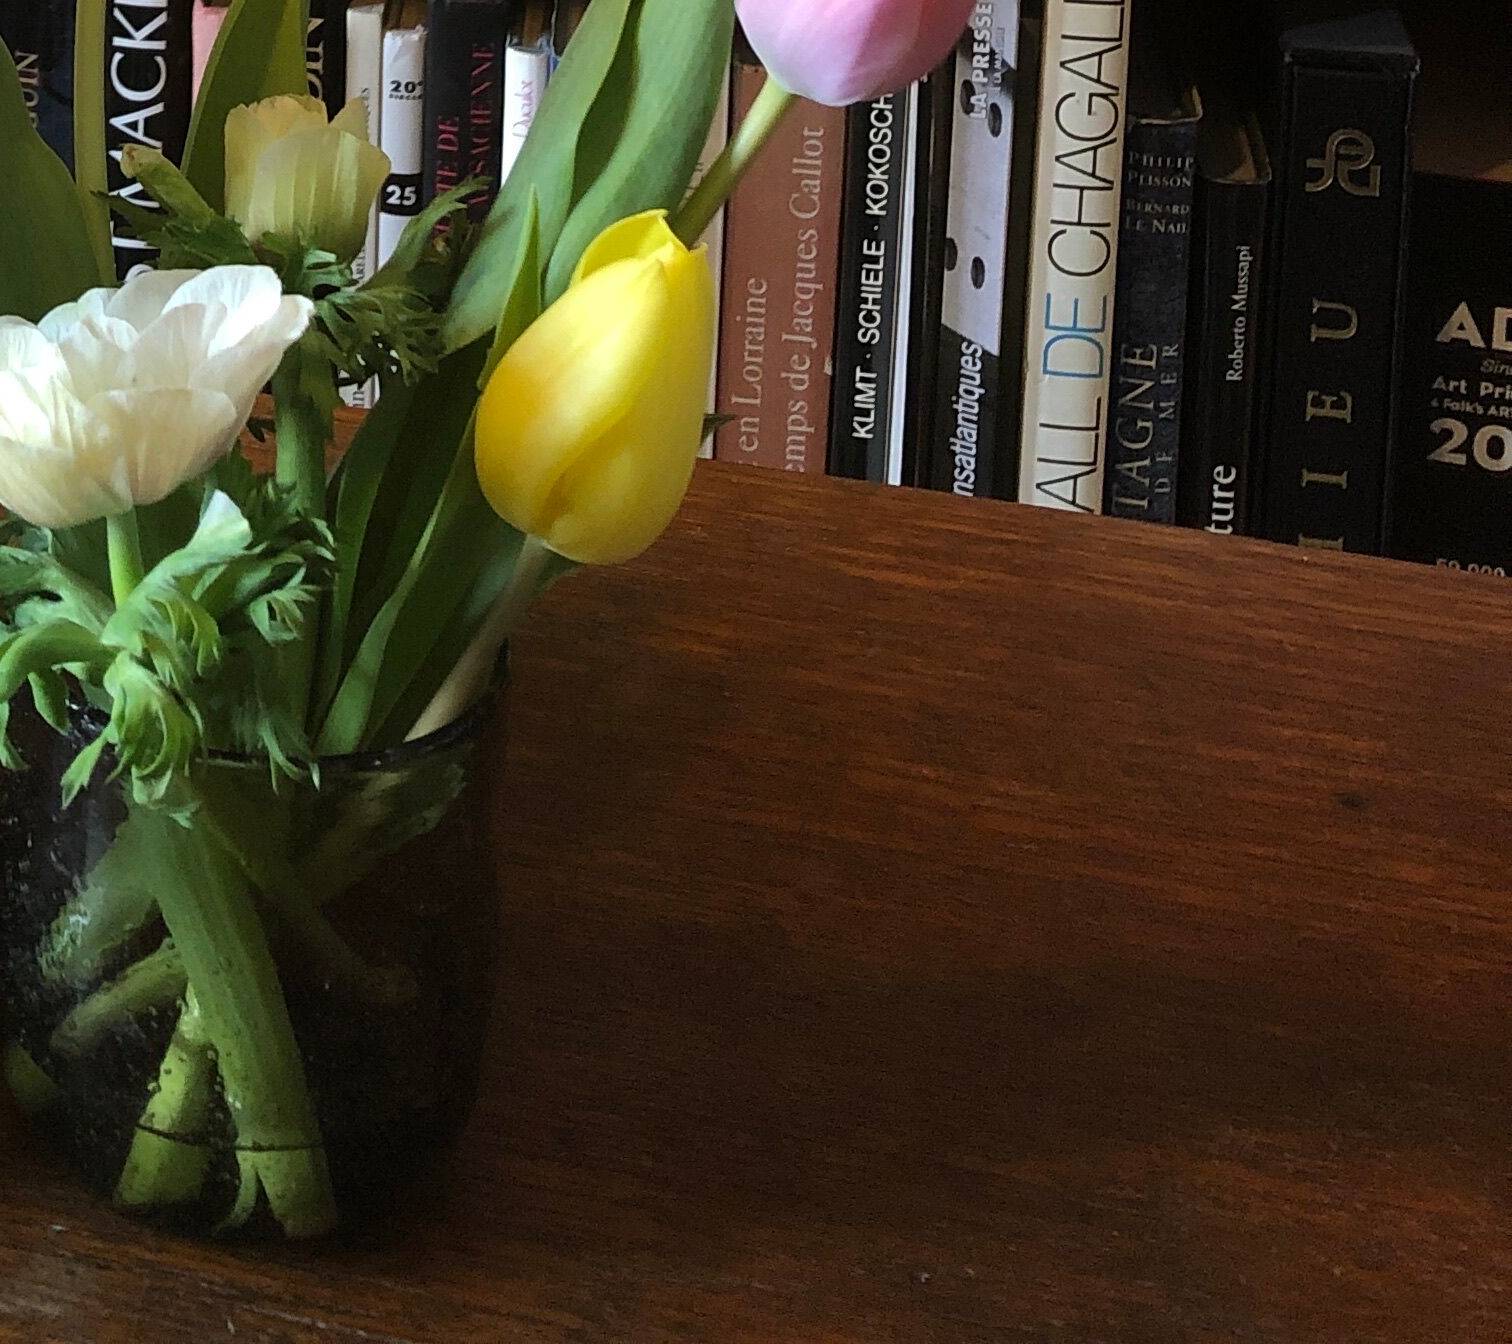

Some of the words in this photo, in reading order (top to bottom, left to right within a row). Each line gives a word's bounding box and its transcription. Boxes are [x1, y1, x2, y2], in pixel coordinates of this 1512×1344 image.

[971, 1, 994, 79] PRESSE
[790, 125, 825, 220] Callot
[783, 227, 825, 353] Jacques
[857, 238, 886, 346] SCHIELE
[741, 275, 769, 413] Lorraine
[1042, 292, 1108, 380] DE
[1225, 312, 1247, 382] Roberto
[790, 360, 812, 407] de
[852, 365, 879, 440] KLIMT
